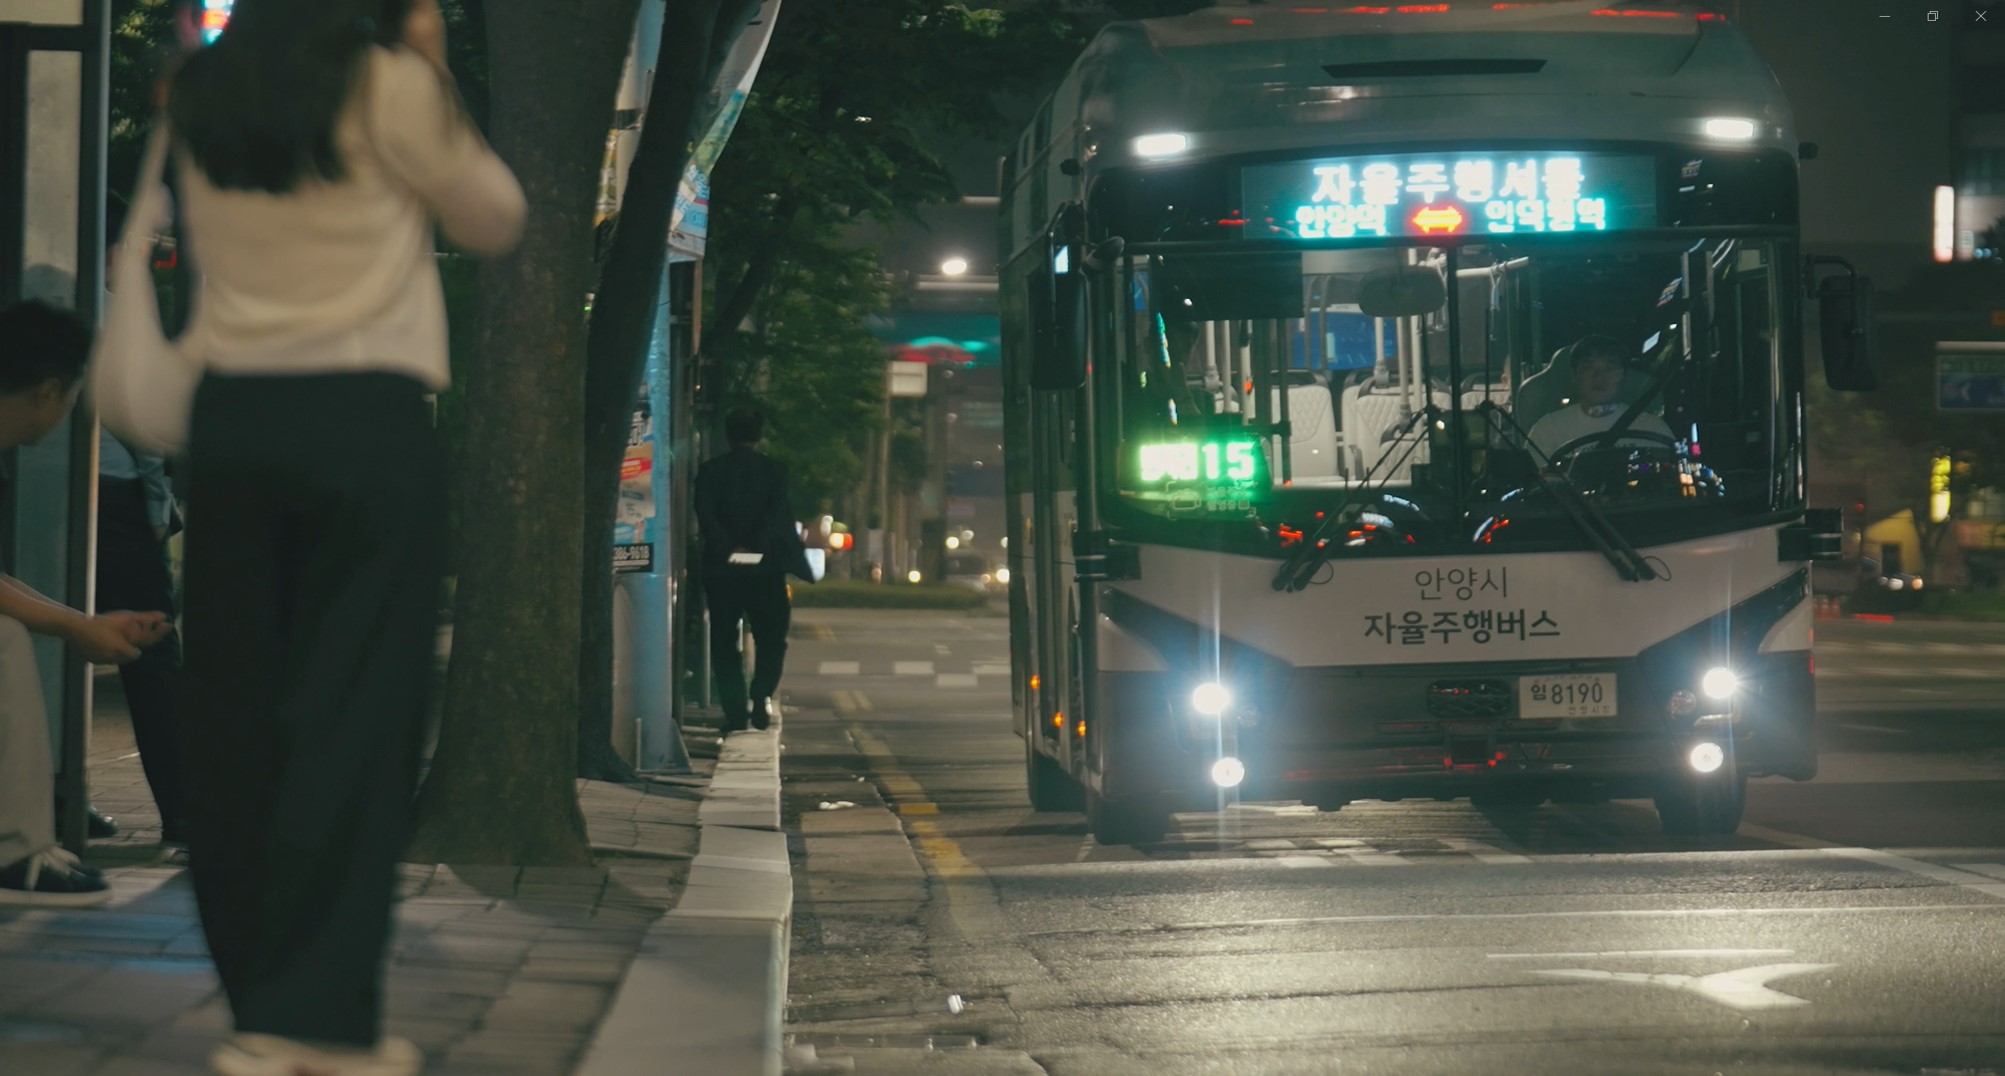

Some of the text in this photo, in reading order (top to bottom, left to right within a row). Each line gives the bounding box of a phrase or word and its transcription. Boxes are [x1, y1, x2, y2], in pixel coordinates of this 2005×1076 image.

[1296, 202, 1387, 237] 안양역
[1201, 443, 1254, 479] 15
[1415, 566, 1508, 601] 안양시
[1363, 608, 1562, 645] 자율주행버스
